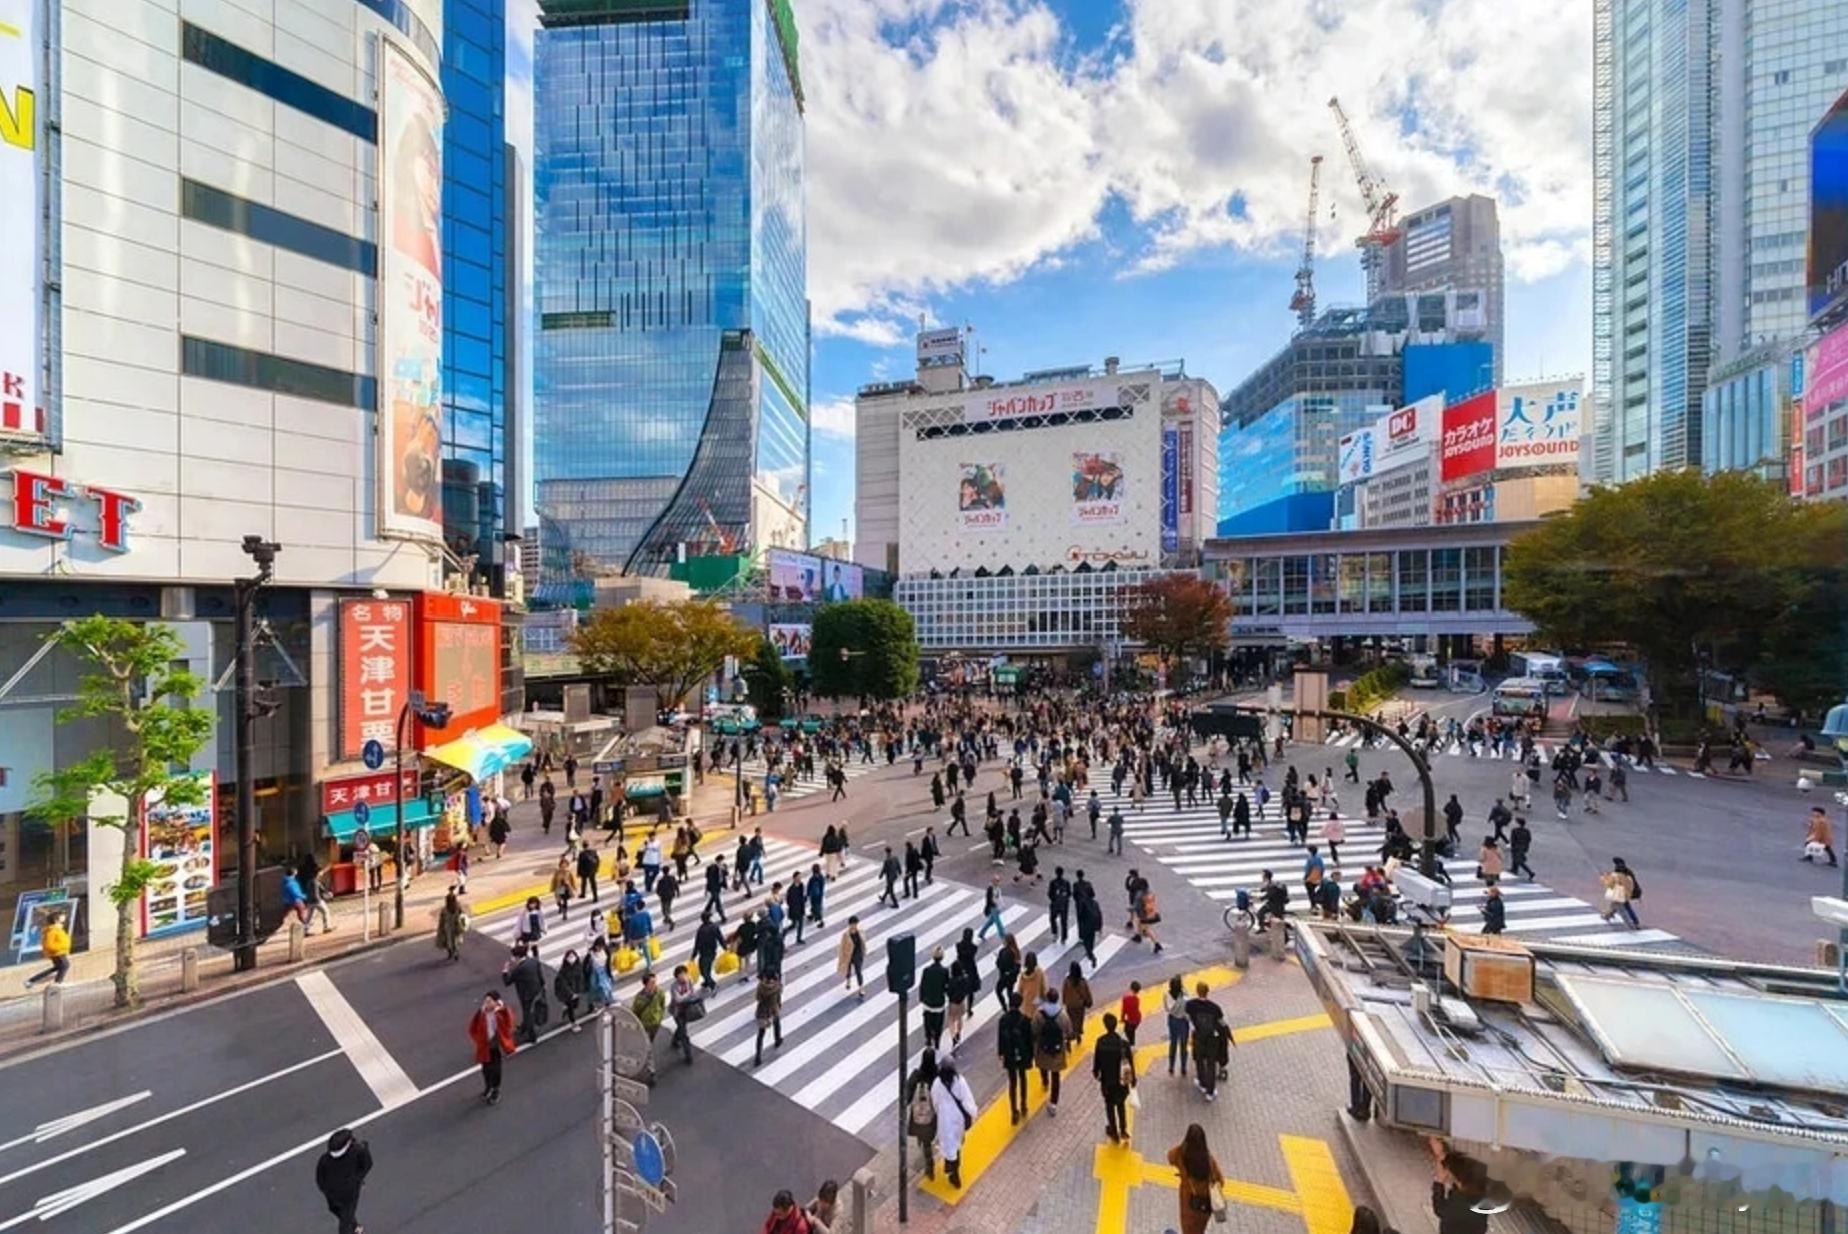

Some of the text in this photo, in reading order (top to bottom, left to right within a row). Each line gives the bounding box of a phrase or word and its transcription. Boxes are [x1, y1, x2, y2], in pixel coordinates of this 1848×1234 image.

[987, 391, 1058, 416] ジャパンカップ
[1391, 411, 1413, 436] DC
[1444, 417, 1493, 448] カラオケ
[1444, 433, 1494, 459] JOYSOUND
[1498, 440, 1579, 458] JOYSOUND
[352, 604, 403, 622] 名物
